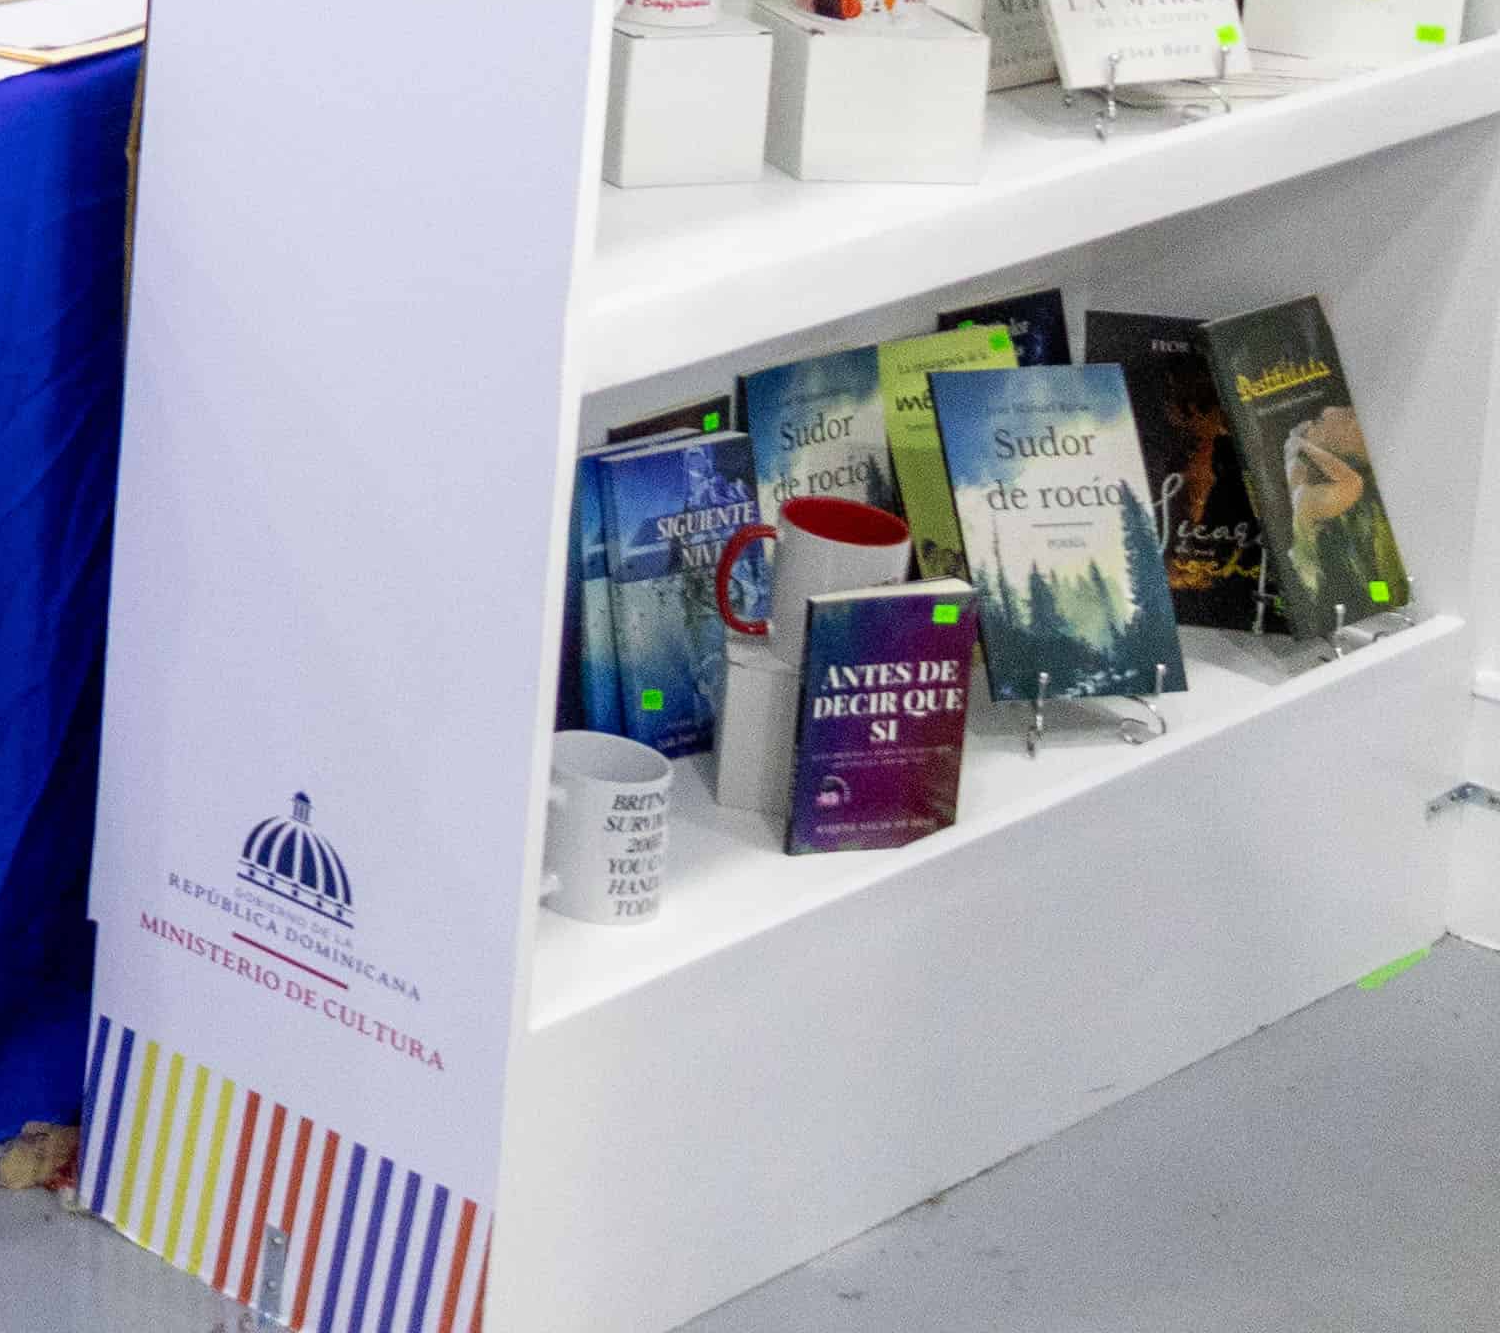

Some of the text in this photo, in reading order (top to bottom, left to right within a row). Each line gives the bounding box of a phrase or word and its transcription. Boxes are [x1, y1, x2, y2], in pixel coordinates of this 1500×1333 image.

[779, 411, 854, 453] Sudor
[994, 425, 1095, 462] Sudor
[987, 478, 1124, 512] de rocío
[656, 499, 757, 541] SIGUIENTE
[822, 659, 960, 690] ANTES DE
[813, 687, 964, 718] DECIR QUE
[167, 871, 421, 1003] REPÚBLICA DOMINICANA
[140, 911, 445, 1072] MINISTERIO DE CULTURA
